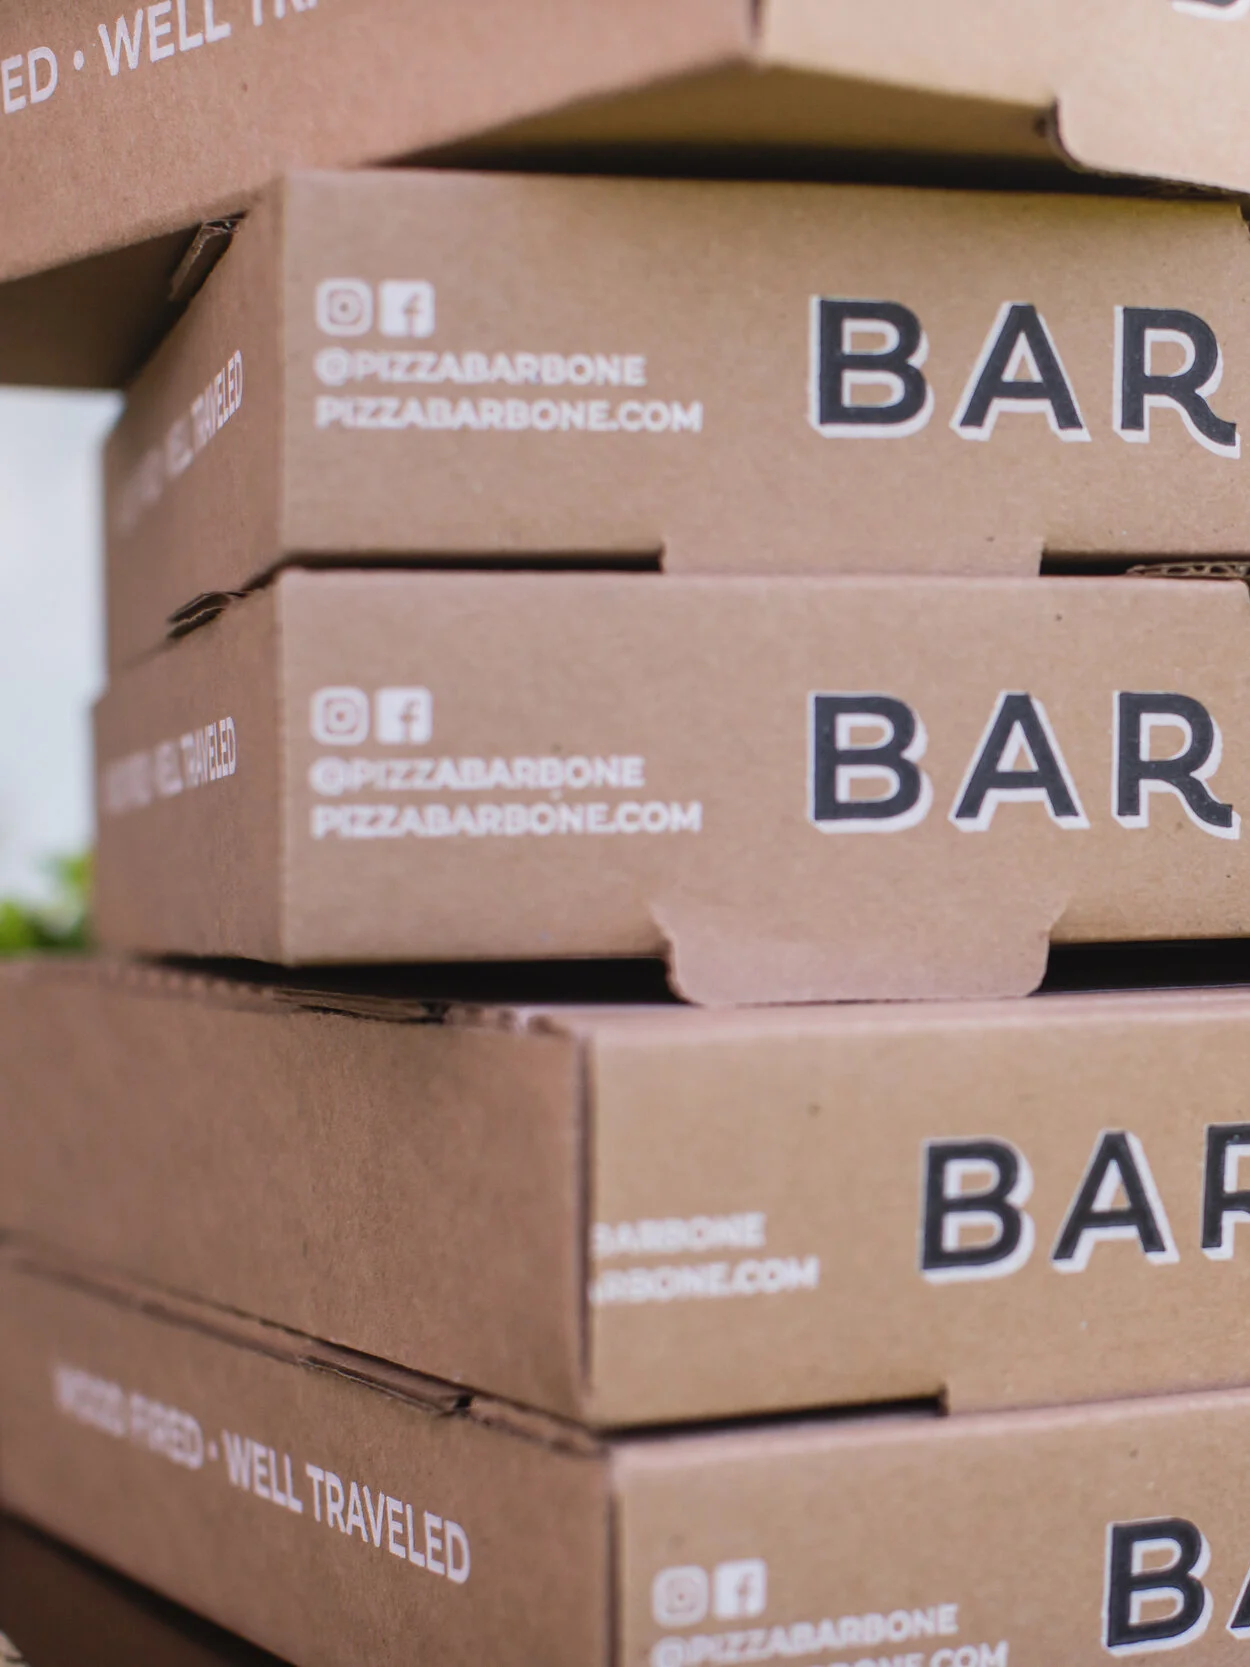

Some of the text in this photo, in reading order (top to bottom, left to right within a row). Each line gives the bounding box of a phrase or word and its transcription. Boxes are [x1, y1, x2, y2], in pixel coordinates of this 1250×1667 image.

[98, 0, 232, 76] WELL
[315, 347, 645, 386] @PIZZABARBONE
[316, 397, 703, 432] PIZZABARBONE.COM
[310, 755, 645, 795] @PIZZABARBONE
[312, 801, 702, 838] PIZZABARBONE.COM
[221, 1429, 303, 1513] WELL
[306, 1463, 471, 1585] TRAVELED
